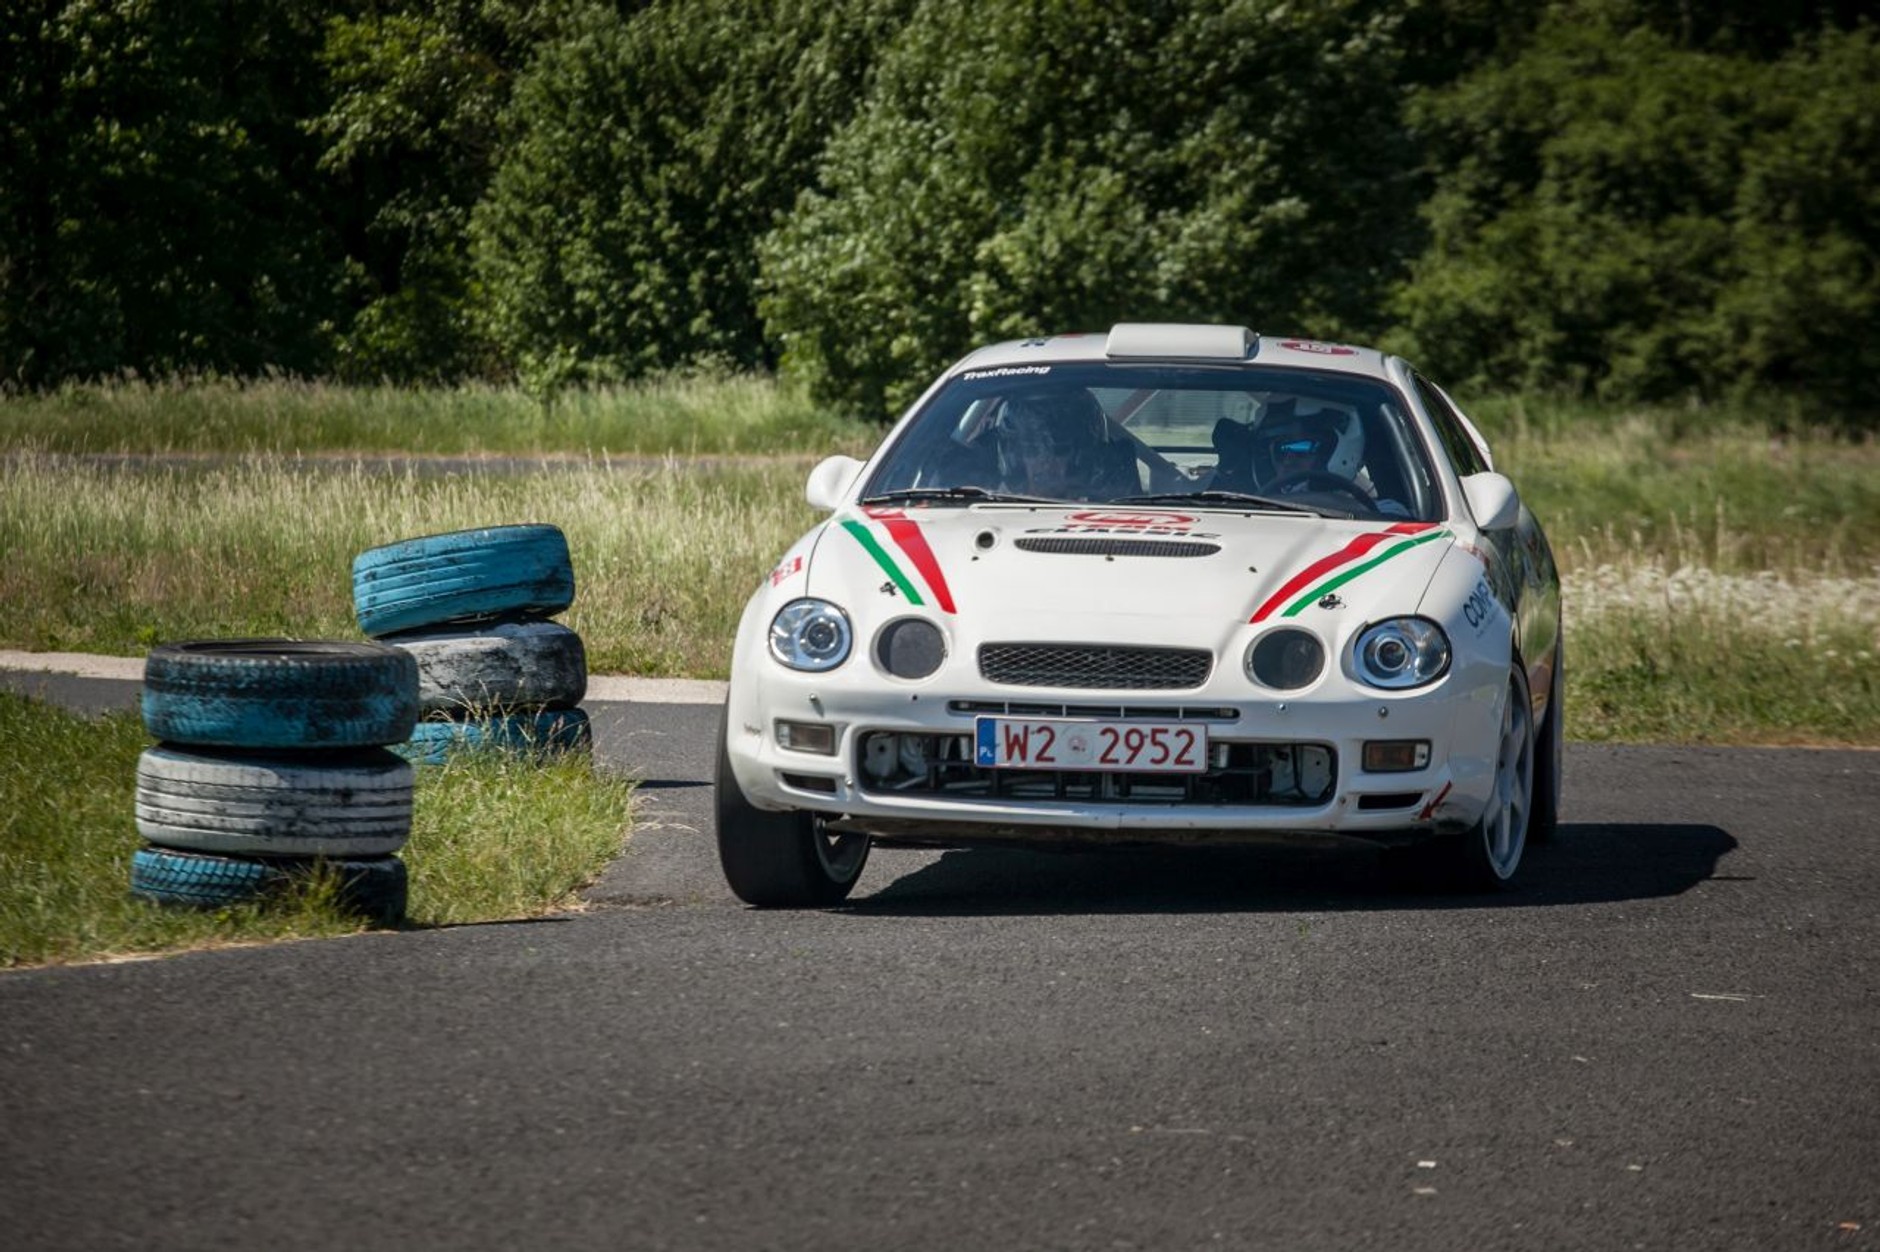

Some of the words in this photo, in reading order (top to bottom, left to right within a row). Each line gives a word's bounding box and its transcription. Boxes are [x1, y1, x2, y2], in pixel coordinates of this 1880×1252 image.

[963, 366, 1051, 380] TraxRacing
[1004, 723, 1056, 763] W2
[1099, 727, 1195, 766] 2952
